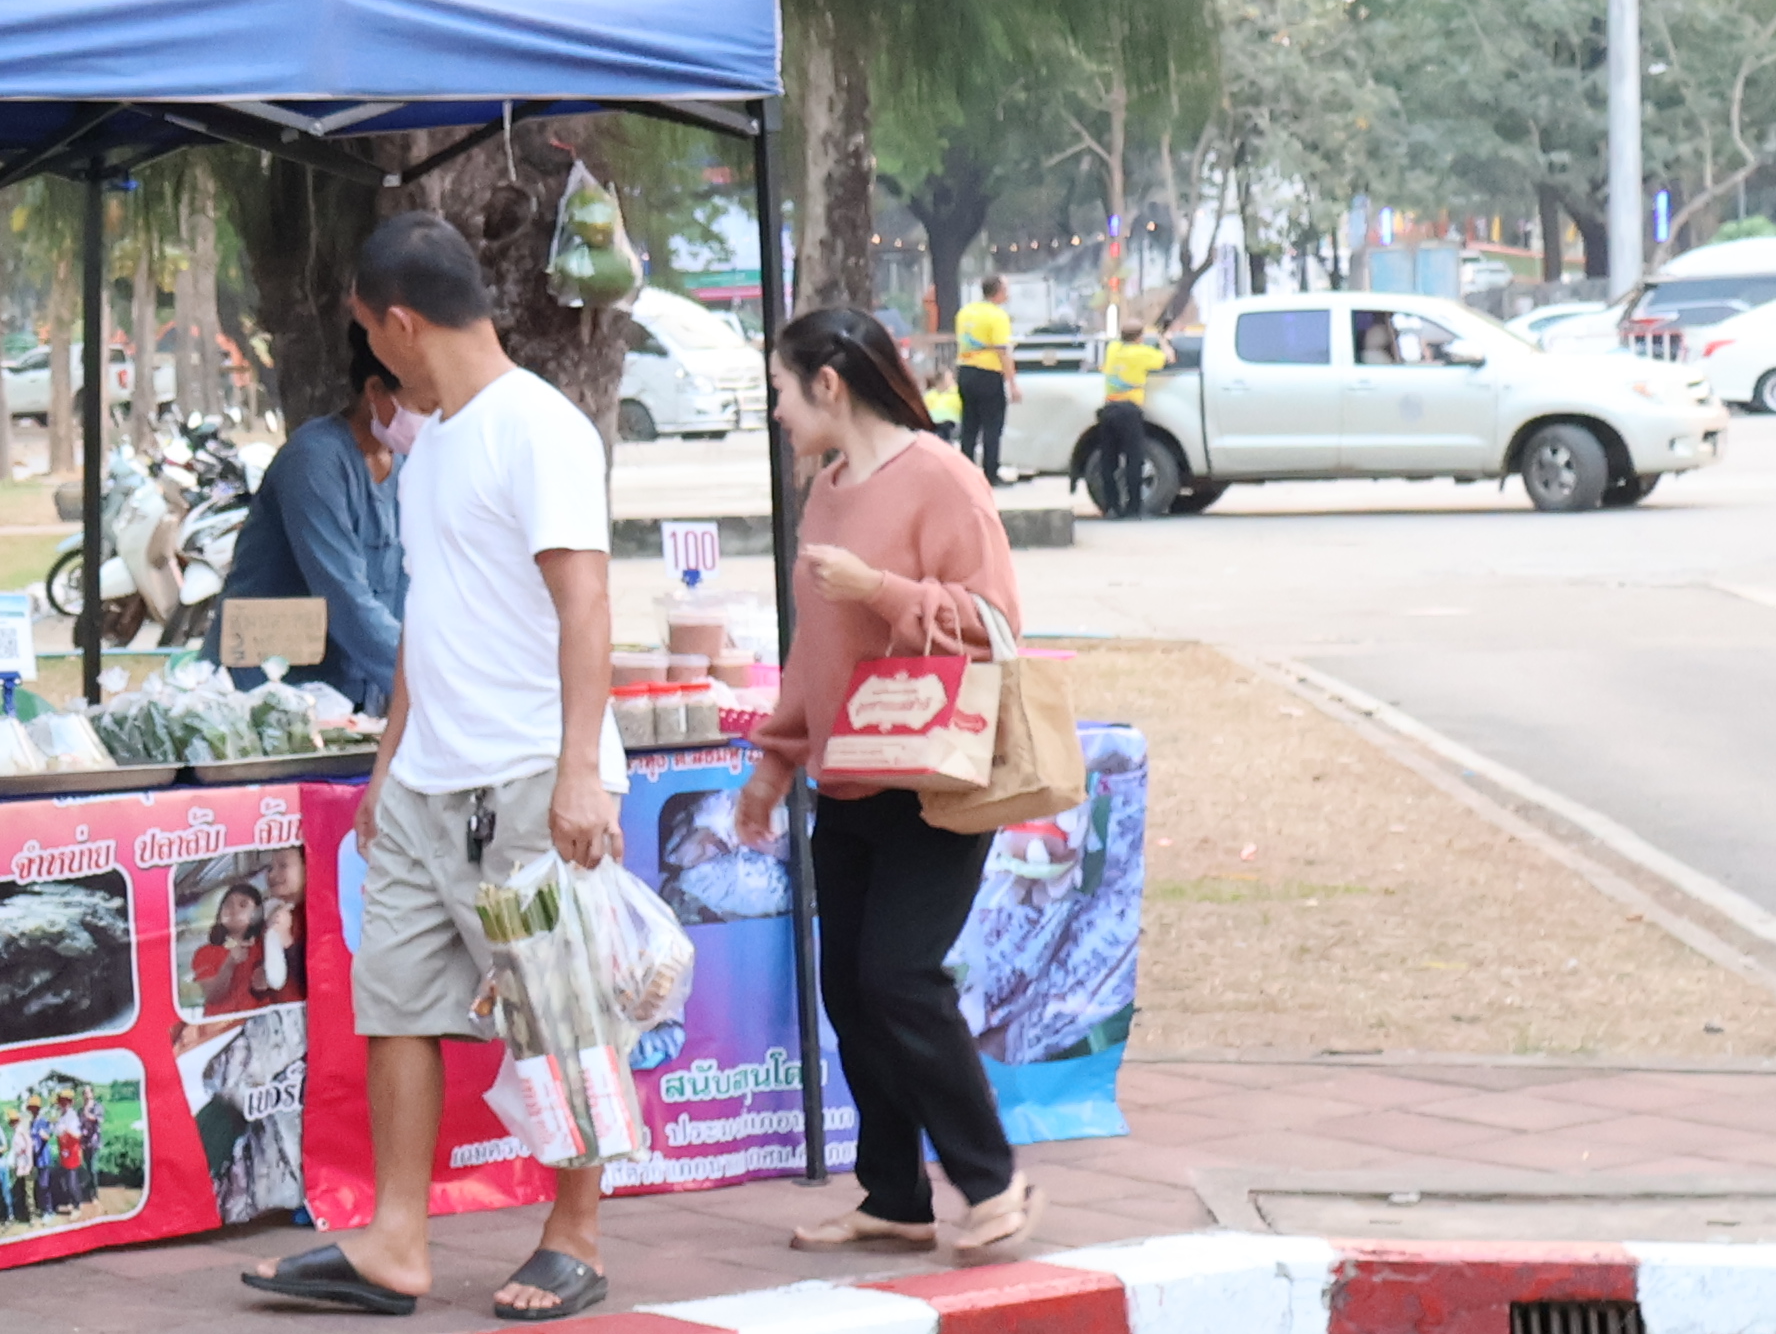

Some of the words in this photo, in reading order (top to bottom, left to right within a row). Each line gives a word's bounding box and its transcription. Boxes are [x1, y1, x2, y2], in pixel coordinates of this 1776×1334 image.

[670, 530, 716, 571] 100
[15, 825, 113, 880] จำหน่าย
[137, 807, 223, 863] ปลาส้ม
